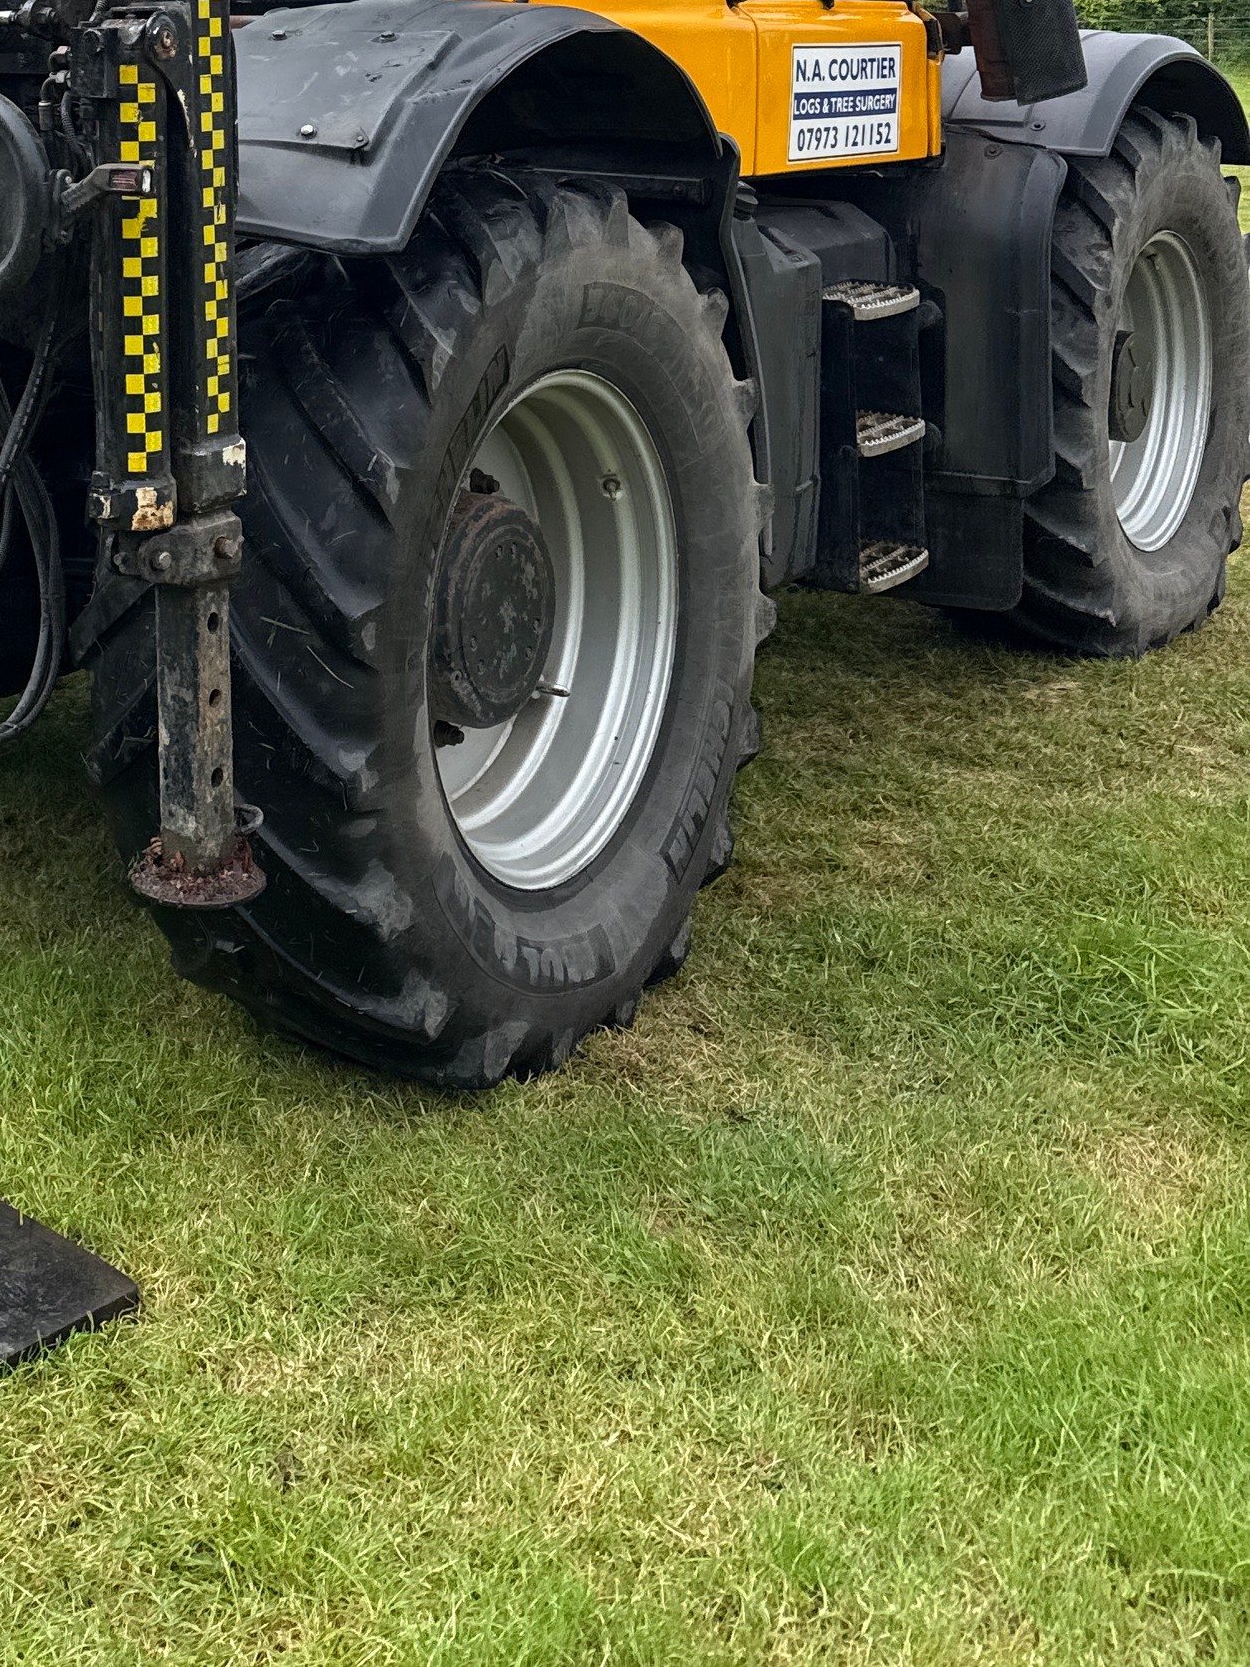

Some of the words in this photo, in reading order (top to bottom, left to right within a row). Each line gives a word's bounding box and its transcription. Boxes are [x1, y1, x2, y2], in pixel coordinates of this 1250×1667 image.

[796, 59, 825, 82] N.A.
[828, 57, 896, 81] COURTIER
[794, 98, 821, 115] LOGS
[822, 97, 830, 114] &
[830, 96, 853, 113] TREE
[855, 93, 896, 111] SURGERY
[797, 126, 838, 151] 07973
[845, 121, 891, 148] 121152
